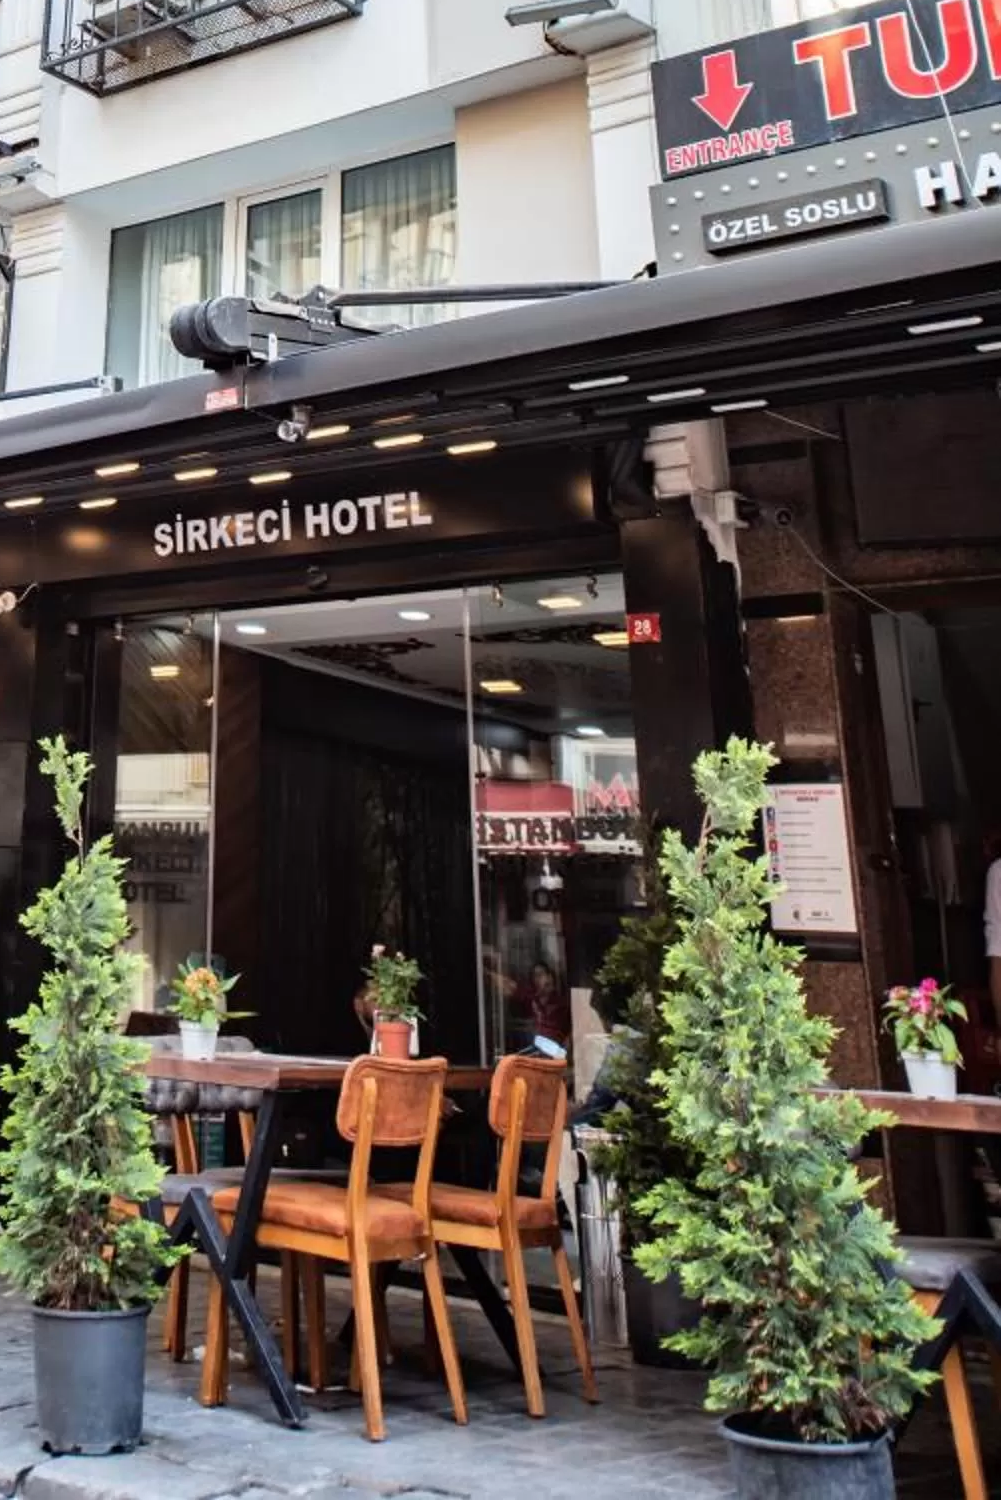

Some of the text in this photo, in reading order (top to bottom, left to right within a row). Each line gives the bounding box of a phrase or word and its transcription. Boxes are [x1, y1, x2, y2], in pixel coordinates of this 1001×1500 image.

[708, 191, 877, 244] ÖZEL SOSLU
[153, 490, 434, 557] SİRKECİ HOTEL
